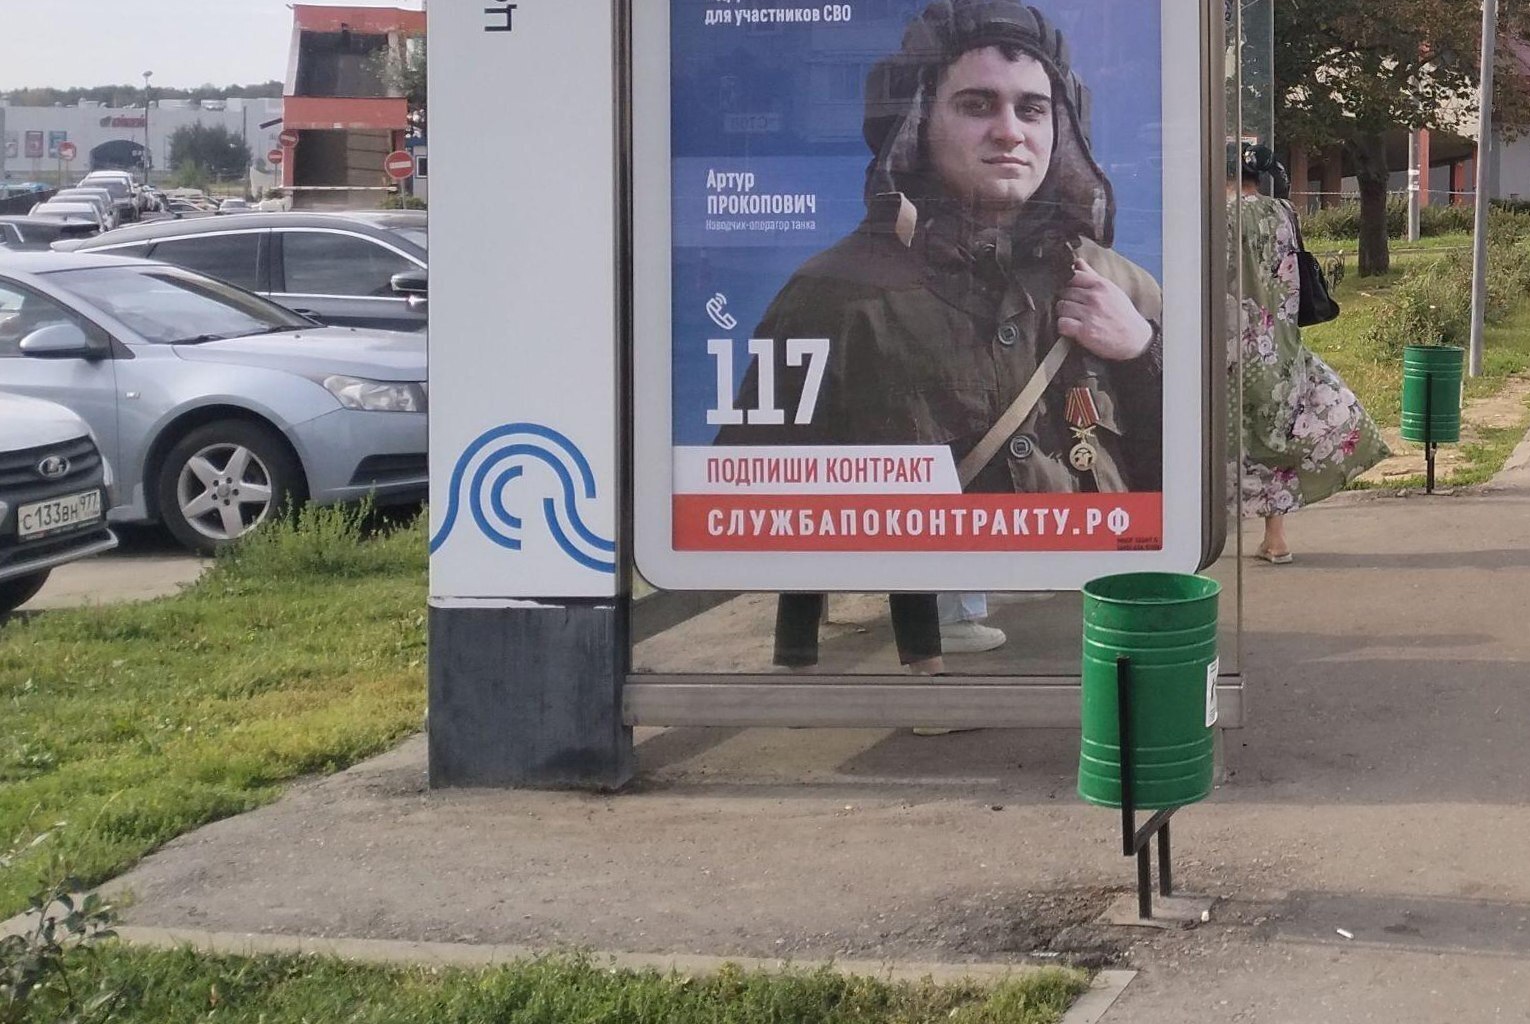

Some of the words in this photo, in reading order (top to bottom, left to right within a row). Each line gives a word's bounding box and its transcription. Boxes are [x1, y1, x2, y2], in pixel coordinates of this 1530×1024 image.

[705, 9, 731, 25] для
[735, 8, 820, 26] участников
[823, 4, 851, 22] СВО
[706, 169, 754, 192] Артур
[707, 194, 815, 214] ПРОКОПОВИЧ
[792, 220, 816, 230] танка
[706, 339, 830, 425] 117
[707, 457, 818, 484] ПОДПИШИ
[827, 457, 934, 483] КОНТРАКТ
[707, 506, 1130, 536] СЛУЖБАПОКОНТРАКТУ.РФ
